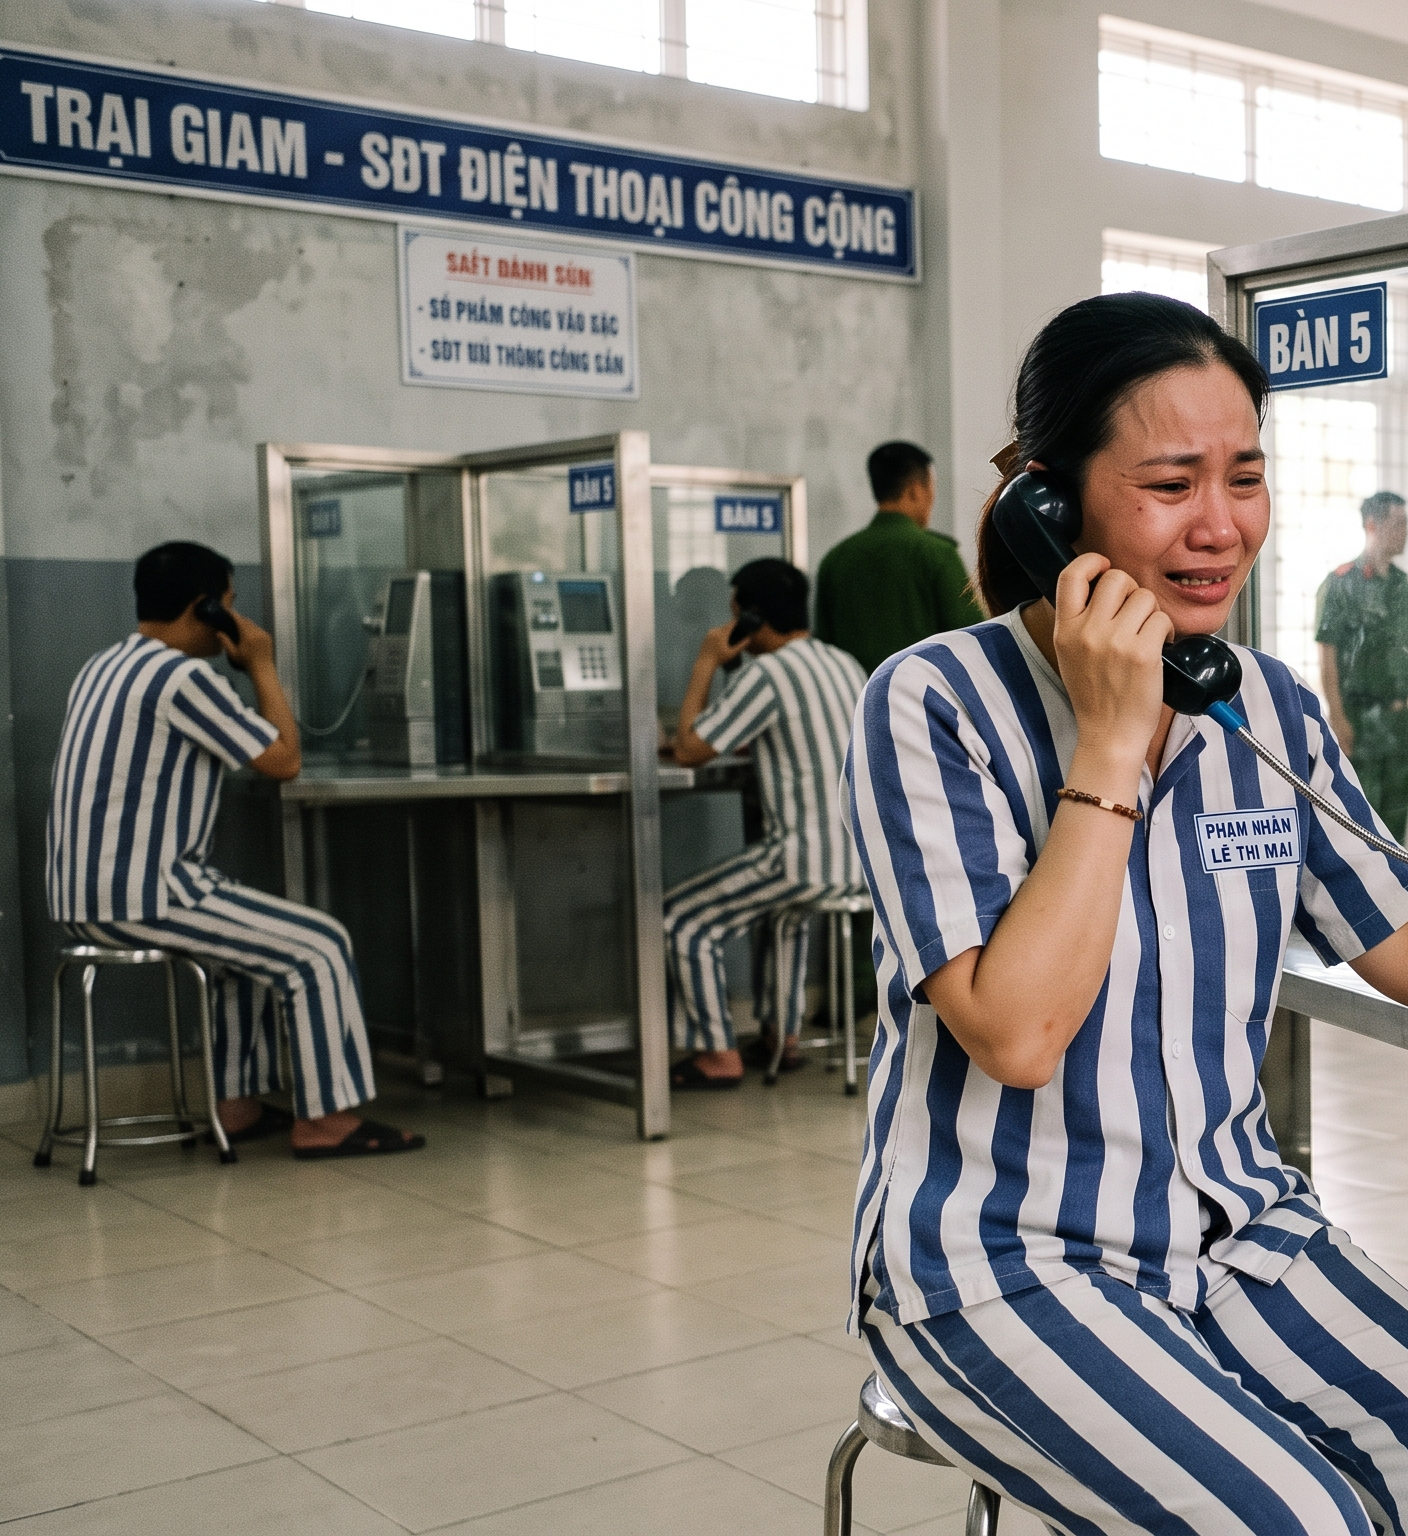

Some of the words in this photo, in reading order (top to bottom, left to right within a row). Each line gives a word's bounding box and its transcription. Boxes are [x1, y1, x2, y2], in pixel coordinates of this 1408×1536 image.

[20, 80, 152, 168] TRẠI
[170, 103, 308, 179] GIAM
[458, 142, 558, 220] ĐIỆN
[569, 163, 684, 238] THOẠI
[695, 175, 795, 243] CÔNG
[803, 190, 897, 259] CỘNG
[1269, 308, 1339, 374] BÀN
[1350, 311, 1371, 363] 5
[1205, 820, 1248, 841] PHẠM
[1236, 844, 1260, 861] THI
[1264, 842, 1293, 859] MAI
